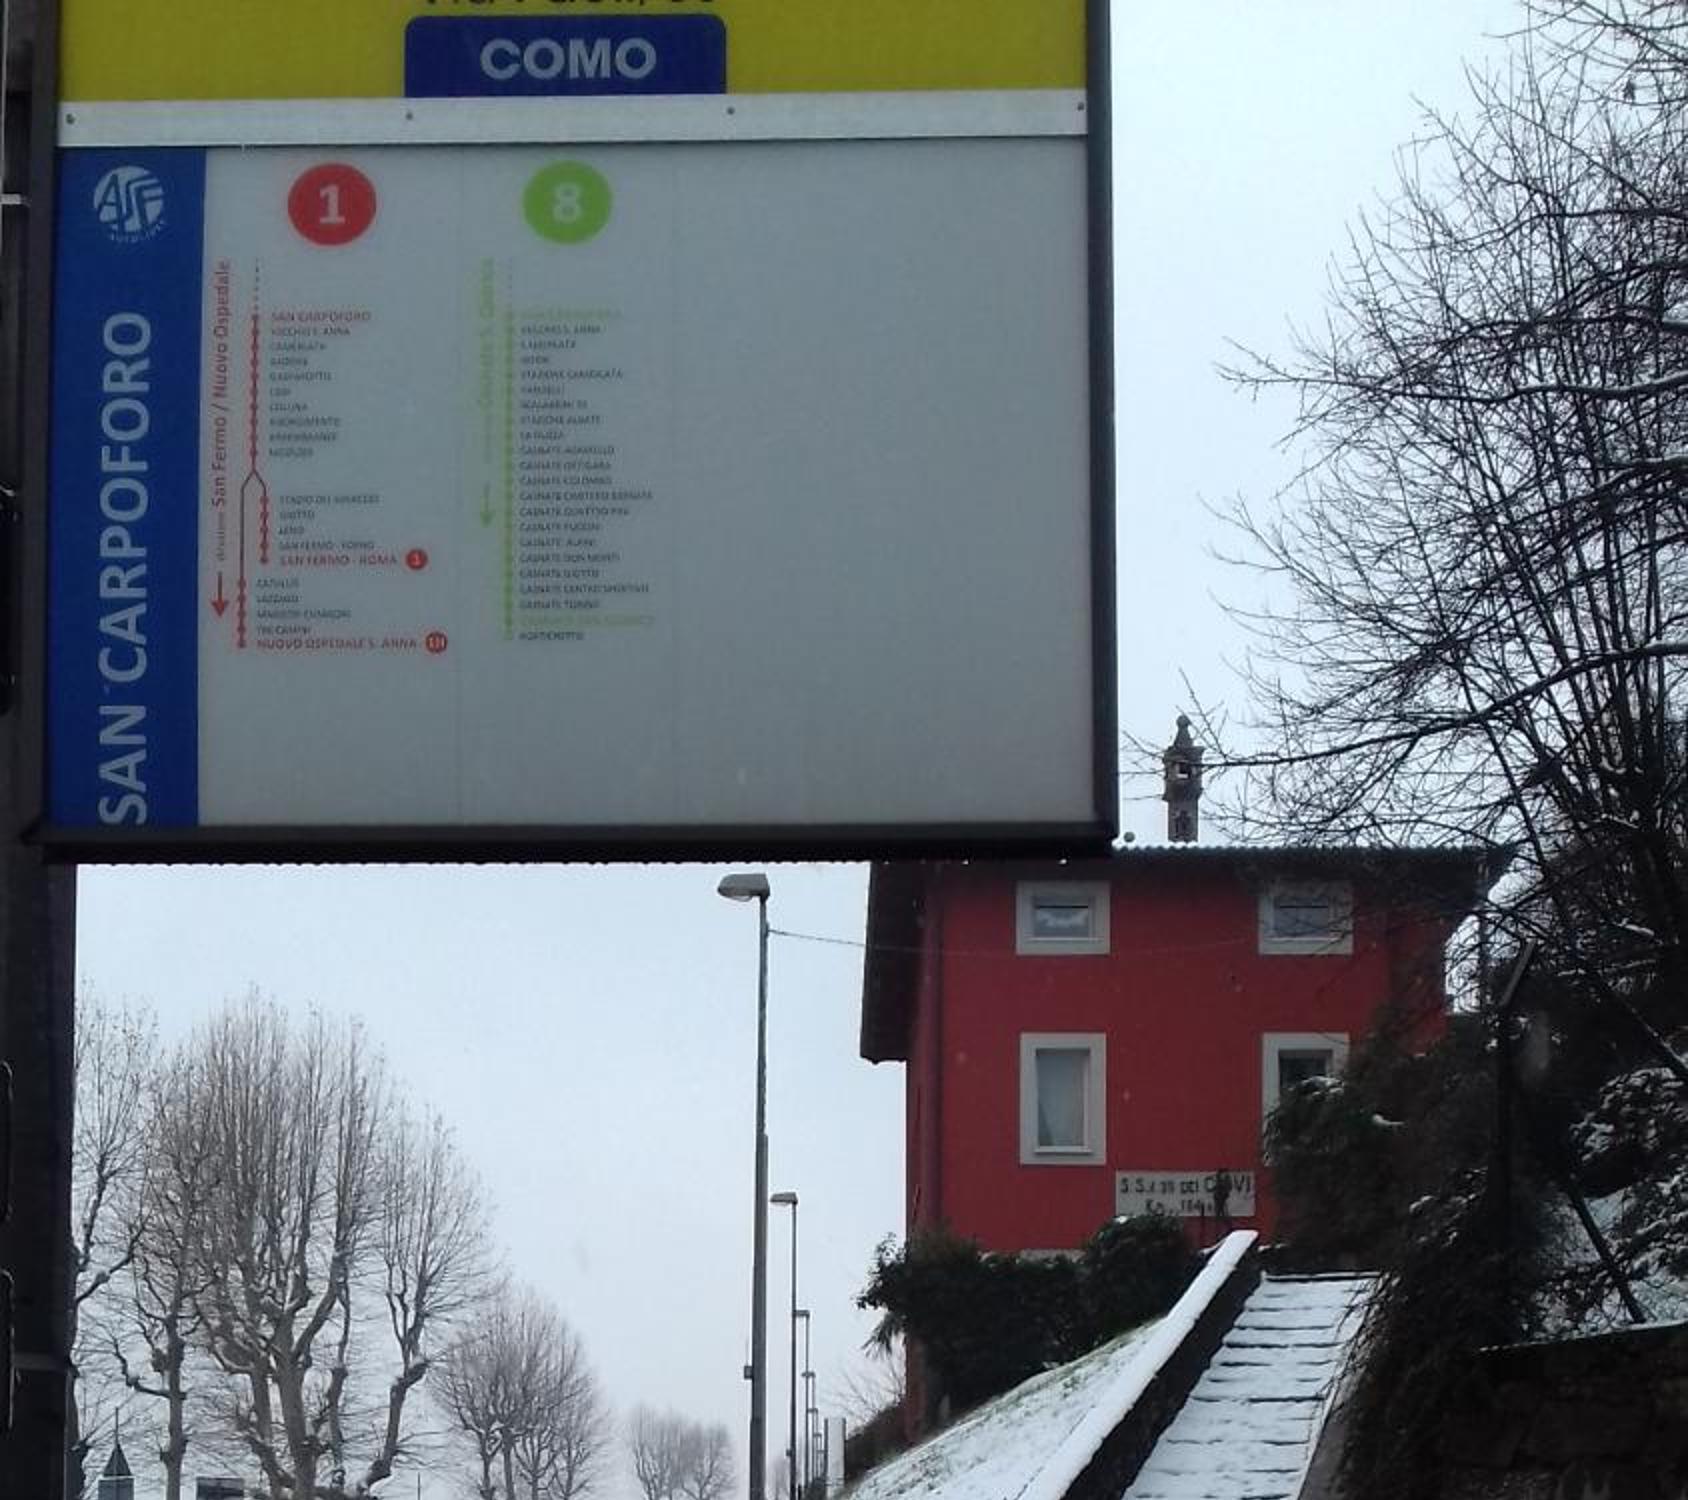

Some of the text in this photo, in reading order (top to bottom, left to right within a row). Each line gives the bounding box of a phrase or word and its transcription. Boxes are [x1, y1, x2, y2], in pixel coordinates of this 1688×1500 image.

[480, 37, 657, 80] COMO
[318, 185, 346, 225] 1
[553, 185, 583, 224] 8
[213, 260, 231, 337] Ospedale
[213, 343, 228, 398] Nuovo
[212, 417, 227, 471] Fermo
[212, 478, 225, 507] San
[99, 311, 151, 826] SAN CARPOFORO
